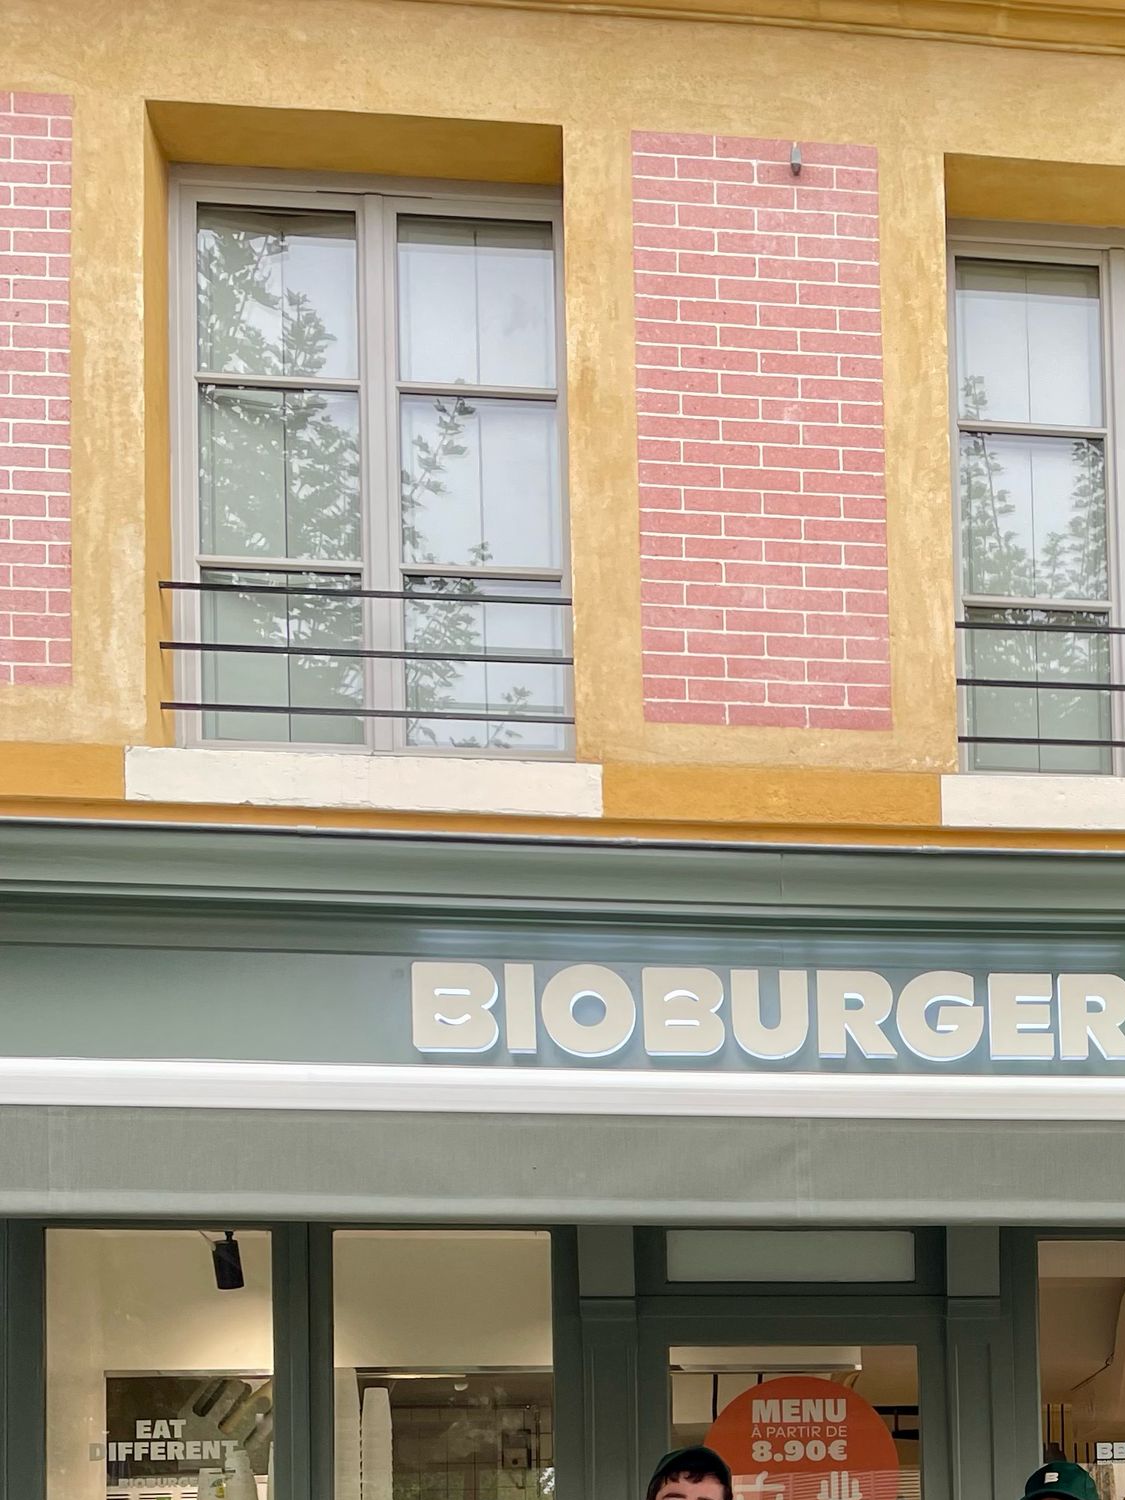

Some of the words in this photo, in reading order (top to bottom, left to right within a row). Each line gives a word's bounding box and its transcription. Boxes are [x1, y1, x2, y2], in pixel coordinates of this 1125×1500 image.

[752, 1399, 847, 1423] MENU
[136, 1419, 186, 1439] EAT
[751, 1424, 762, 1438] À
[766, 1426, 821, 1438] PARTIR
[826, 1426, 847, 1438] DE
[89, 1440, 238, 1461] DIFFERENT
[752, 1439, 847, 1462] 8.90€
[118, 1477, 199, 1489] BIOBURGE
